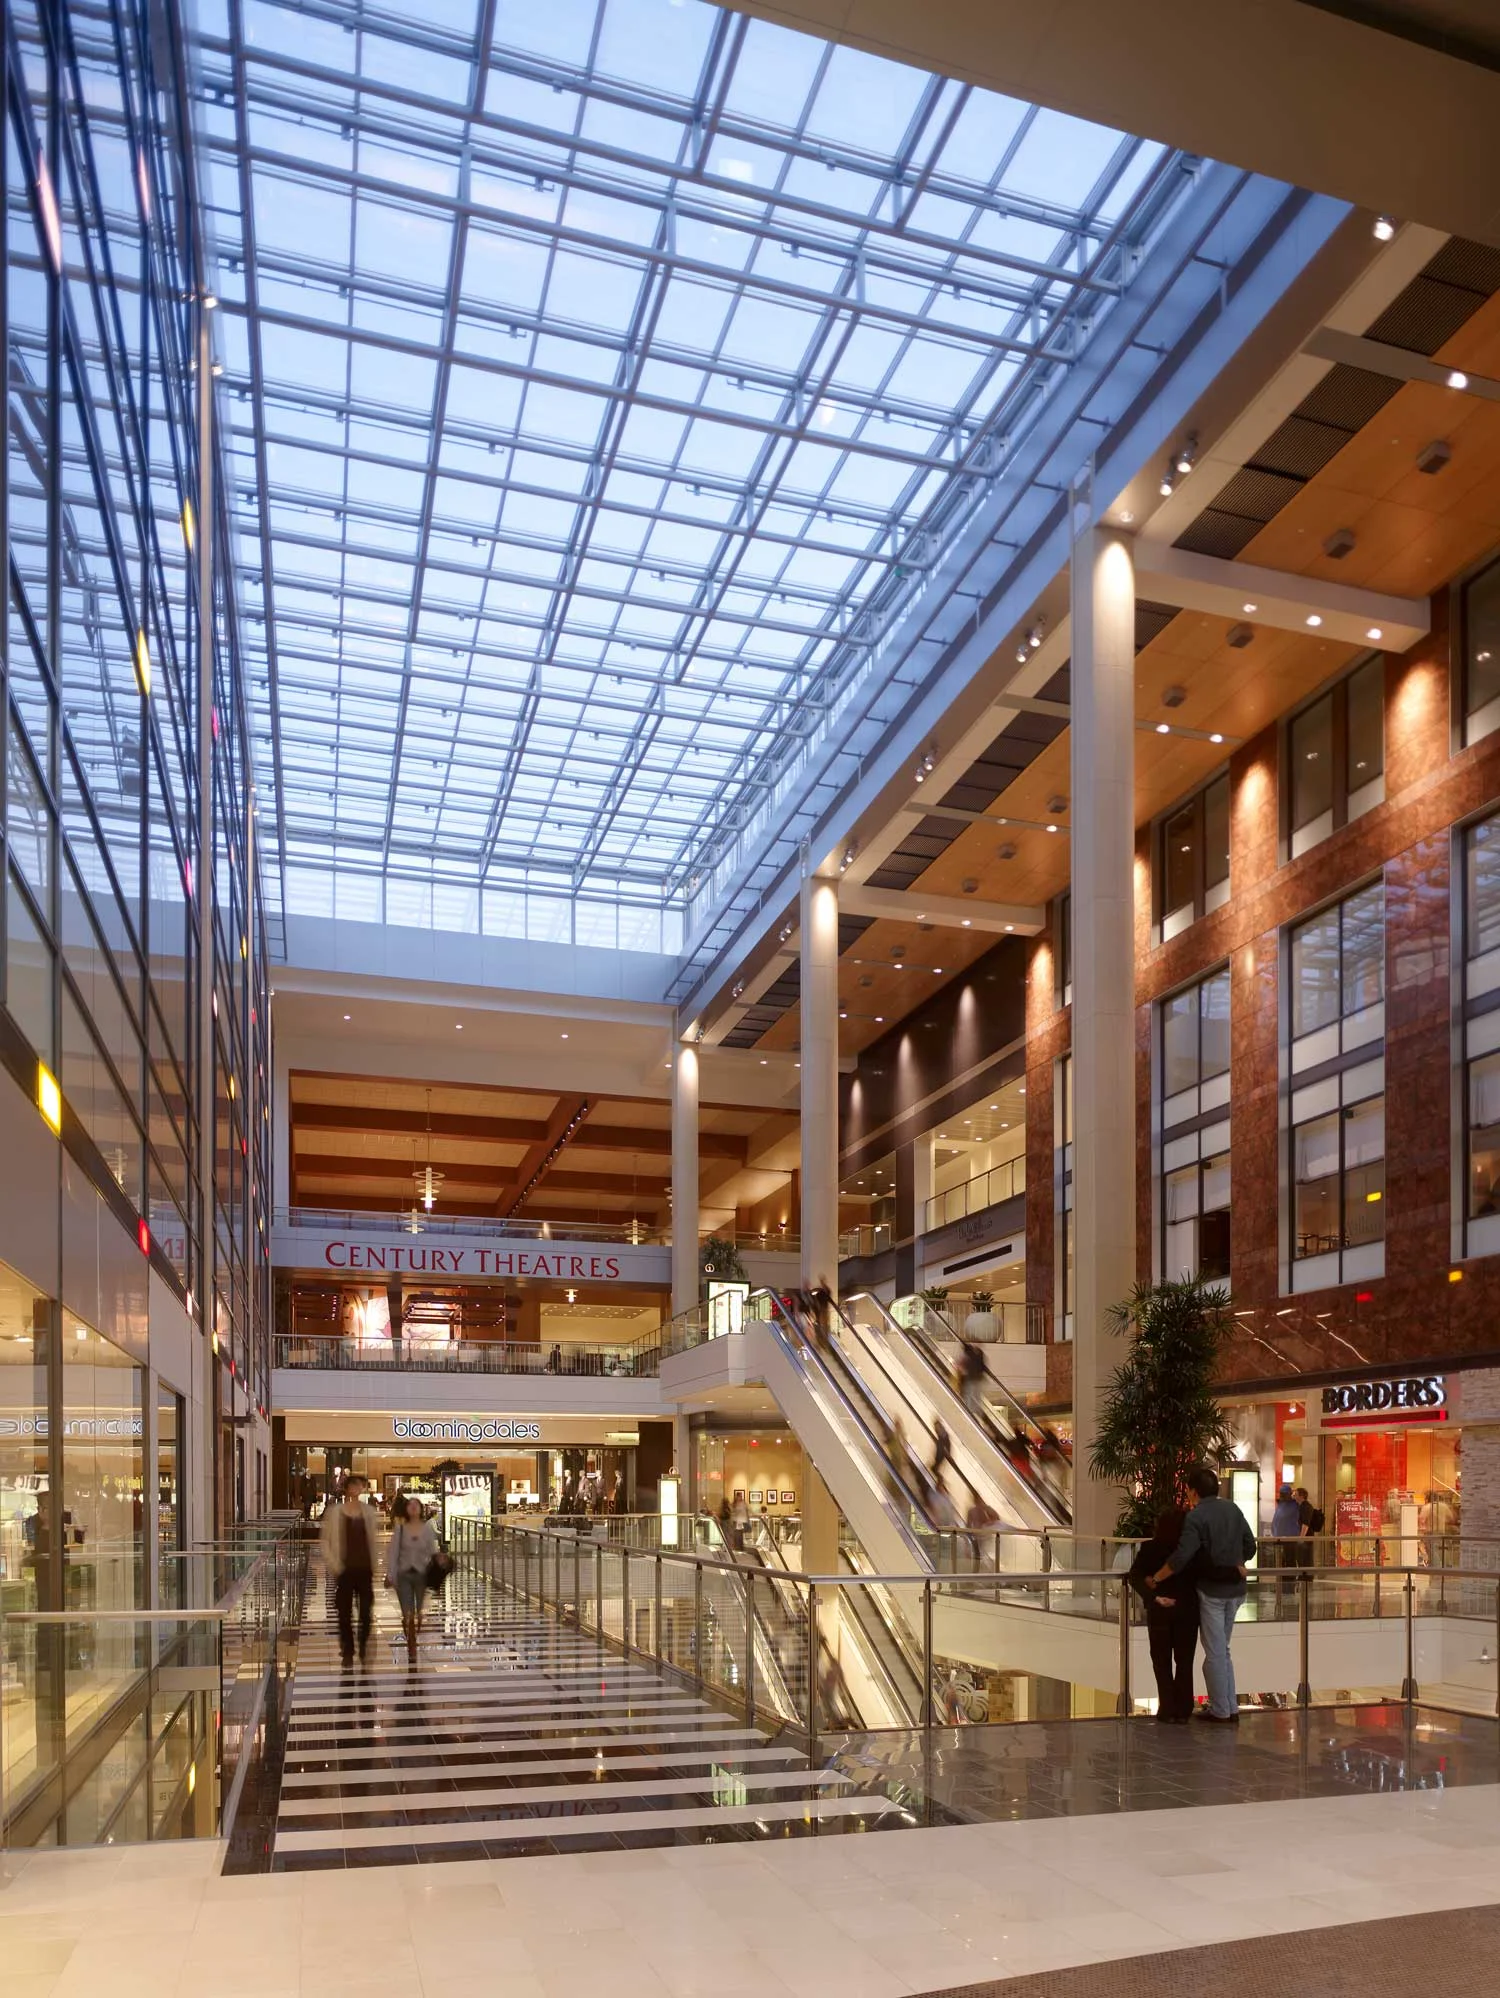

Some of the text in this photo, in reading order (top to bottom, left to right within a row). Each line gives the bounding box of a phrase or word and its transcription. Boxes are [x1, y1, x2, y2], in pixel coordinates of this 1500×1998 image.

[325, 1242, 620, 1278] CENTURY THEATRES
[1321, 1376, 1443, 1413] BORDERS
[393, 1418, 541, 1442] bloomingdale's
